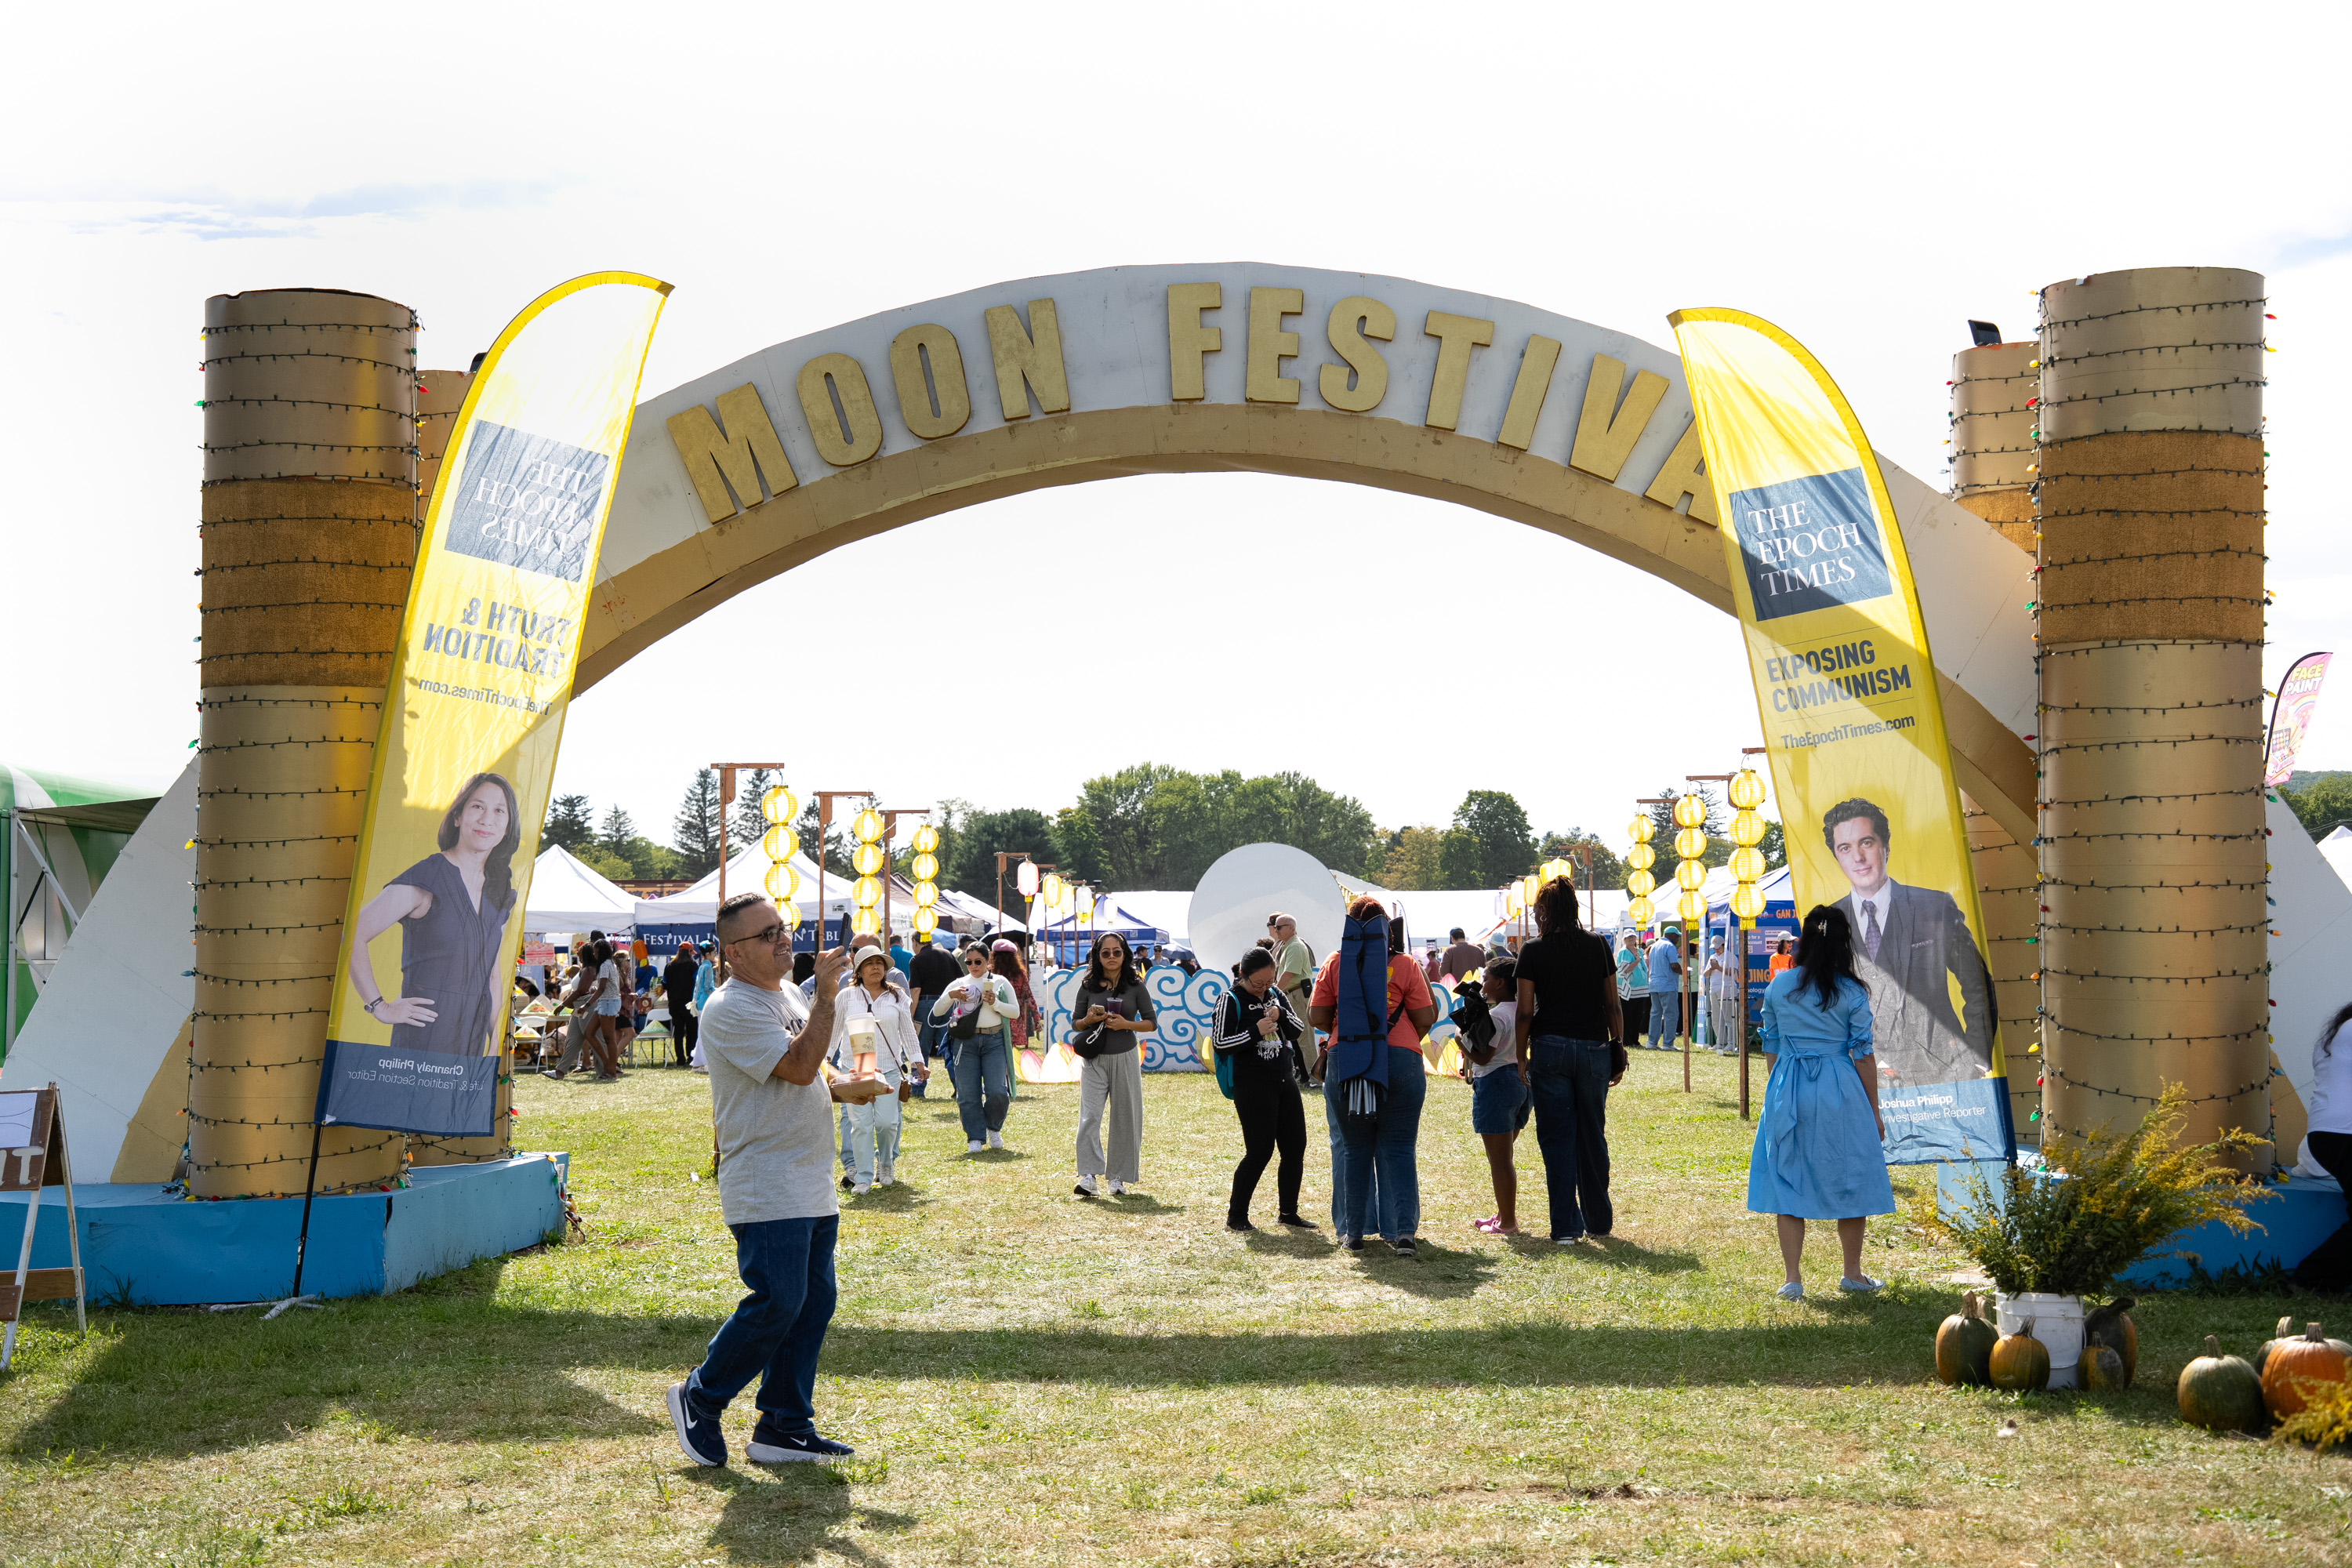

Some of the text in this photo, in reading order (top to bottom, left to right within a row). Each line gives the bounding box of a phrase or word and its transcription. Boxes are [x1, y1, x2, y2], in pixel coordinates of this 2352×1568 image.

[666, 281, 1718, 528] MOON FESTIVA
[1748, 500, 1811, 535] THE
[1755, 522, 1864, 566] EPOCH
[1760, 555, 1856, 597] TIMES
[1766, 640, 1875, 684] EXPOSING
[2291, 662, 2324, 682] FACE
[1772, 664, 1912, 713] COMMUNISM
[2283, 677, 2322, 696] PAINT
[1780, 715, 1915, 750] TheEpochTimes.com
[1776, 909, 1791, 919] GAN
[1878, 1094, 1953, 1109] Joshua Philipp
[1882, 1106, 1987, 1125] Investigative Reporter
